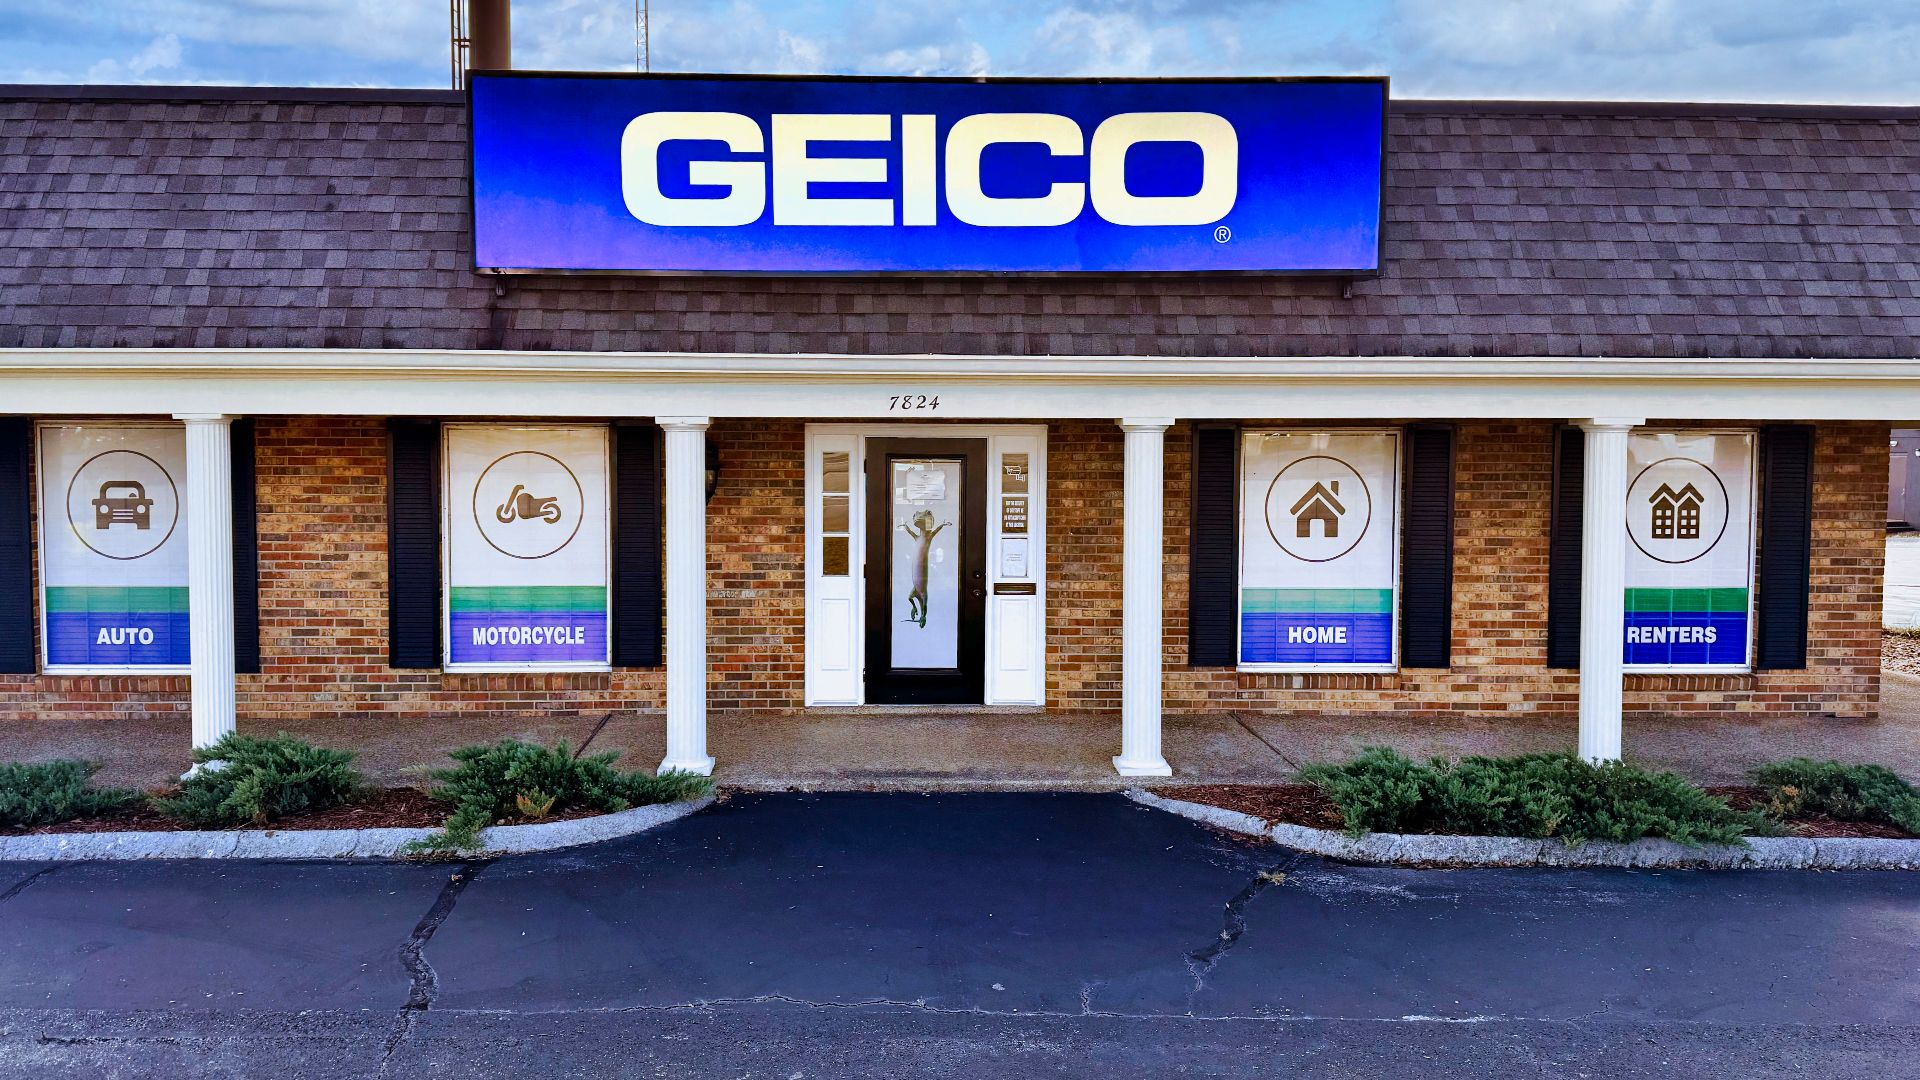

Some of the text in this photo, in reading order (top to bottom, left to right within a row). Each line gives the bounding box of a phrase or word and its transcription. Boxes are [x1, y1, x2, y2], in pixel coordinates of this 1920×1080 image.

[620, 111, 1239, 227] GEICO
[889, 395, 940, 411] 7824
[96, 627, 154, 645] AUTO
[472, 626, 585, 645] MOTORCYCLE
[1288, 626, 1347, 644] HOME
[1627, 626, 1717, 644] RENTERS
